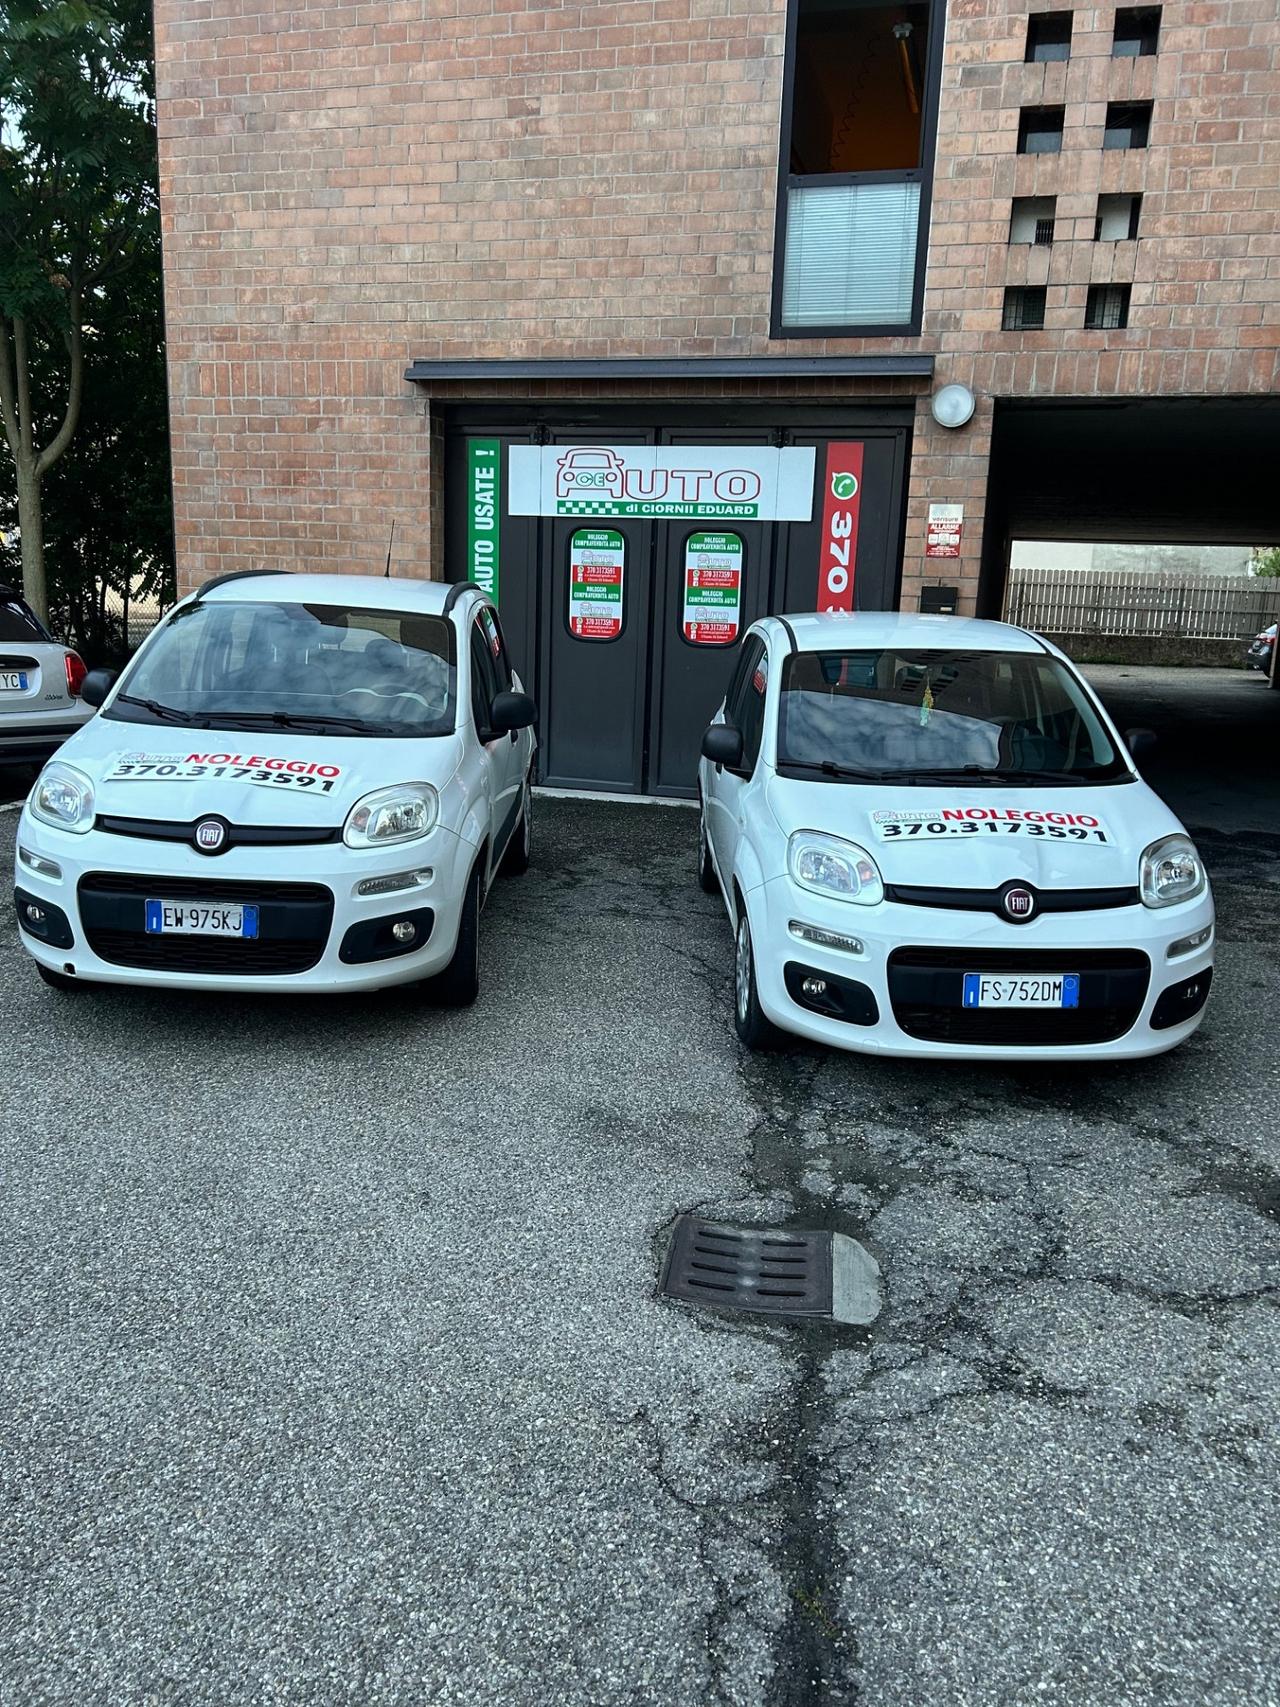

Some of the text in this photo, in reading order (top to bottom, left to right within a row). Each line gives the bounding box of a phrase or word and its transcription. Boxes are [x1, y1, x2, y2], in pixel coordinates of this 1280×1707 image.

[474, 467, 494, 530] USATE
[641, 504, 694, 514] CIORNII
[698, 505, 754, 515] EDUARD
[827, 511, 852, 594] 370
[474, 539, 494, 593] AUTO
[183, 754, 341, 778] NOLEGGIO
[113, 765, 335, 792] 370.3173591
[942, 808, 1099, 827] NOLEGGIO
[202, 828, 219, 842] FIAT
[883, 821, 1108, 843] 370.3173591
[1012, 897, 1028, 910] FIAT
